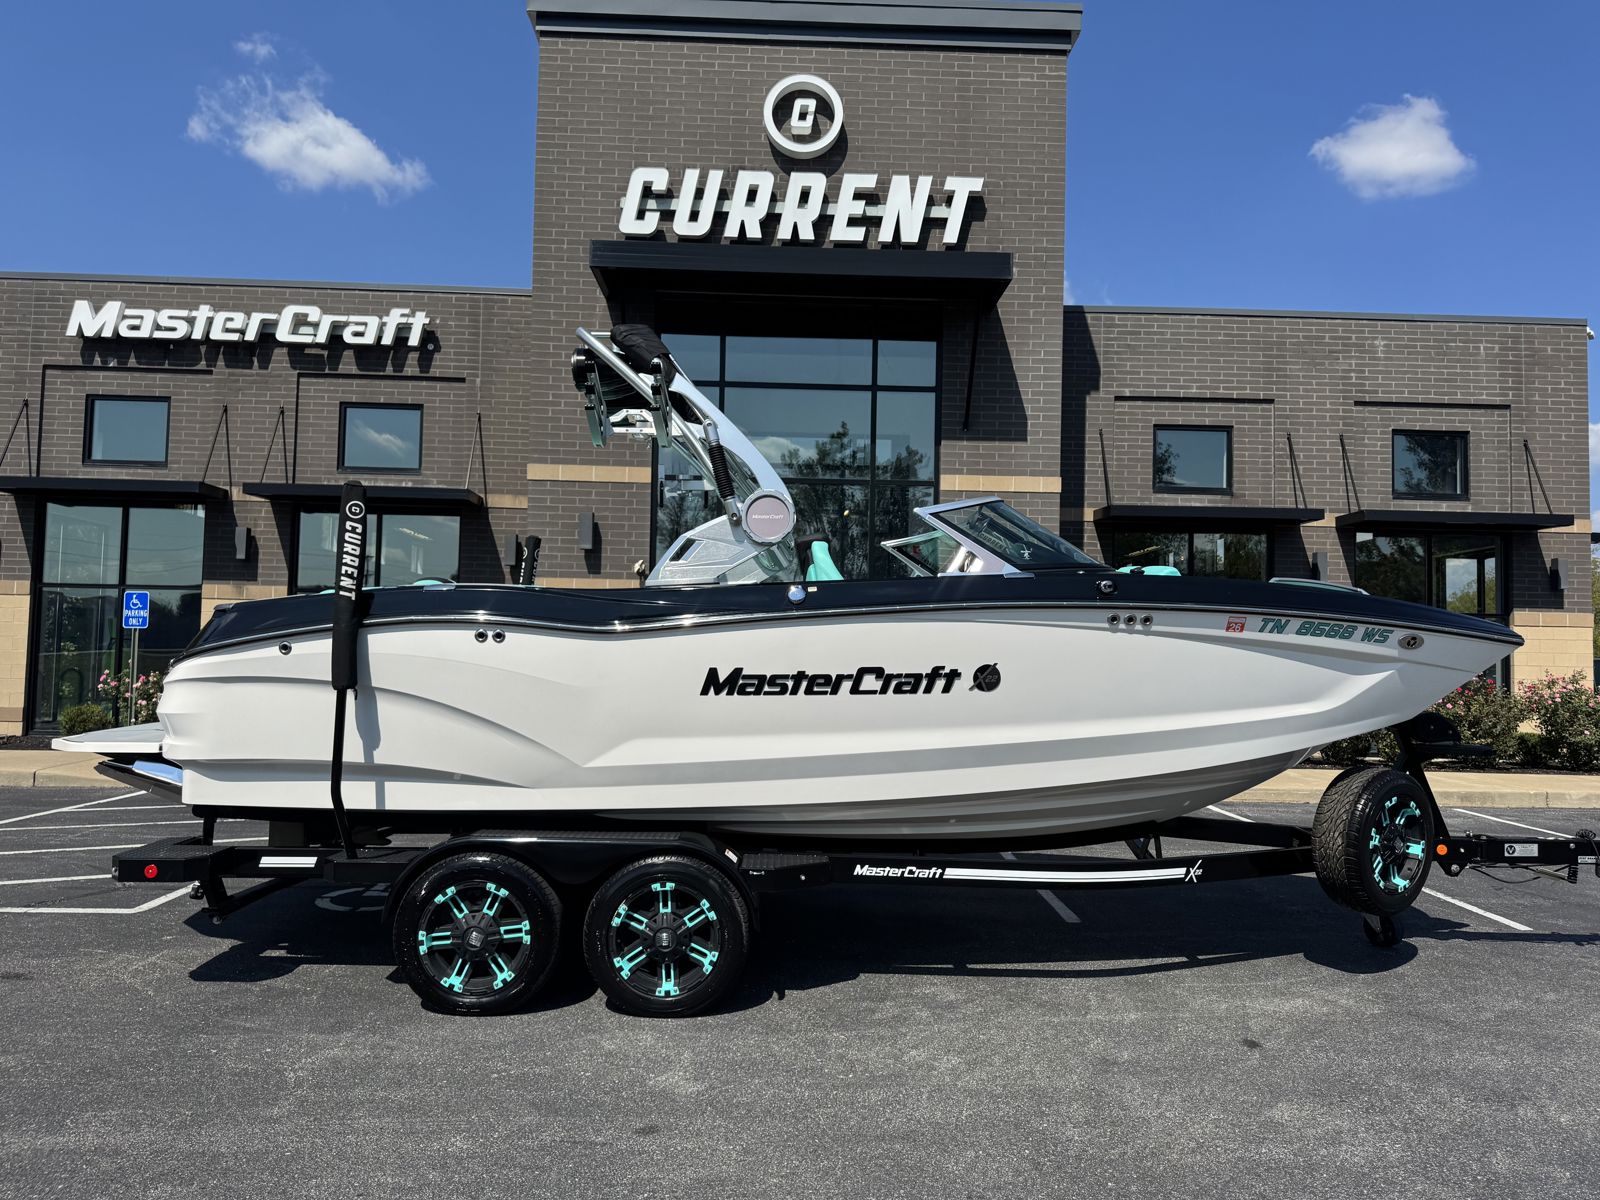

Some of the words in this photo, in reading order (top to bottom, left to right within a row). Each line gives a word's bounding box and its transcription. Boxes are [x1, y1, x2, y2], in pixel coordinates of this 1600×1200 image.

[618, 166, 985, 245] CURRENT
[65, 300, 430, 347] MasterCraft
[339, 520, 363, 601] CURRENT
[128, 617, 143, 625] ONLY
[1258, 618, 1291, 634] TN
[1295, 621, 1358, 639] 8566
[1360, 627, 1394, 643] WS
[700, 666, 962, 696] MasterCraft
[853, 864, 943, 879] MasterCraft
